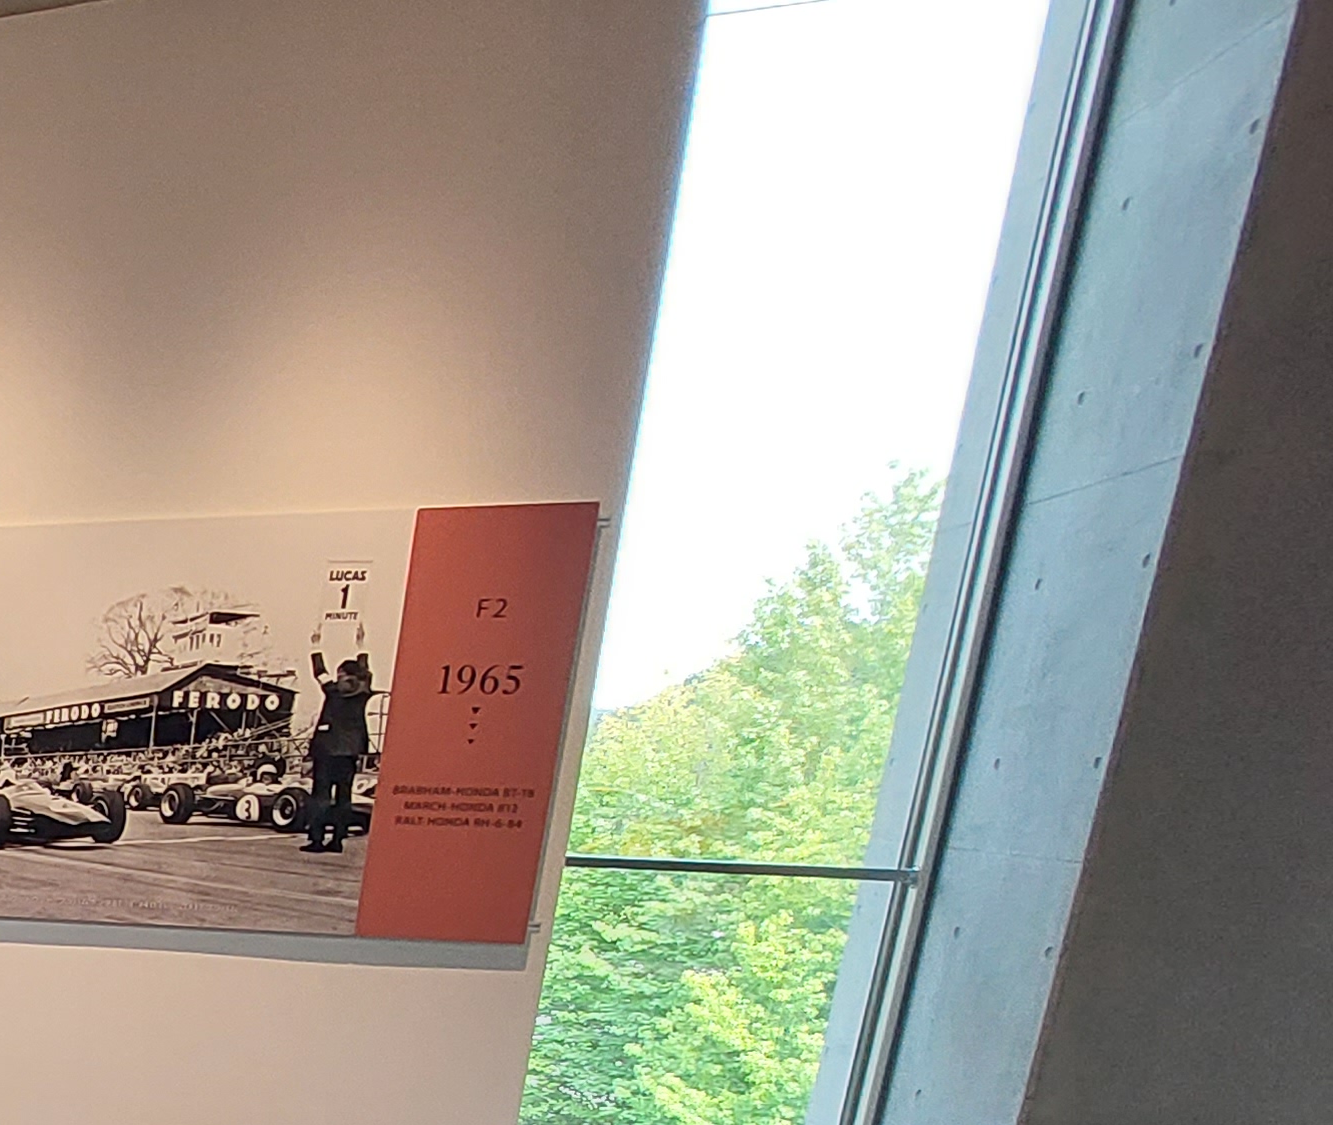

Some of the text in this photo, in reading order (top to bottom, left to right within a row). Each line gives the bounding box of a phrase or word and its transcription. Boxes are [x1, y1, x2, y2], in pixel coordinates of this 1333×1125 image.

[329, 570, 367, 582] LUCAS
[341, 584, 351, 609] 1
[325, 612, 359, 621] MINUTE
[476, 598, 508, 618] F2
[437, 664, 524, 695] 1965
[172, 690, 280, 711] FERODO
[46, 703, 101, 723] FERODO
